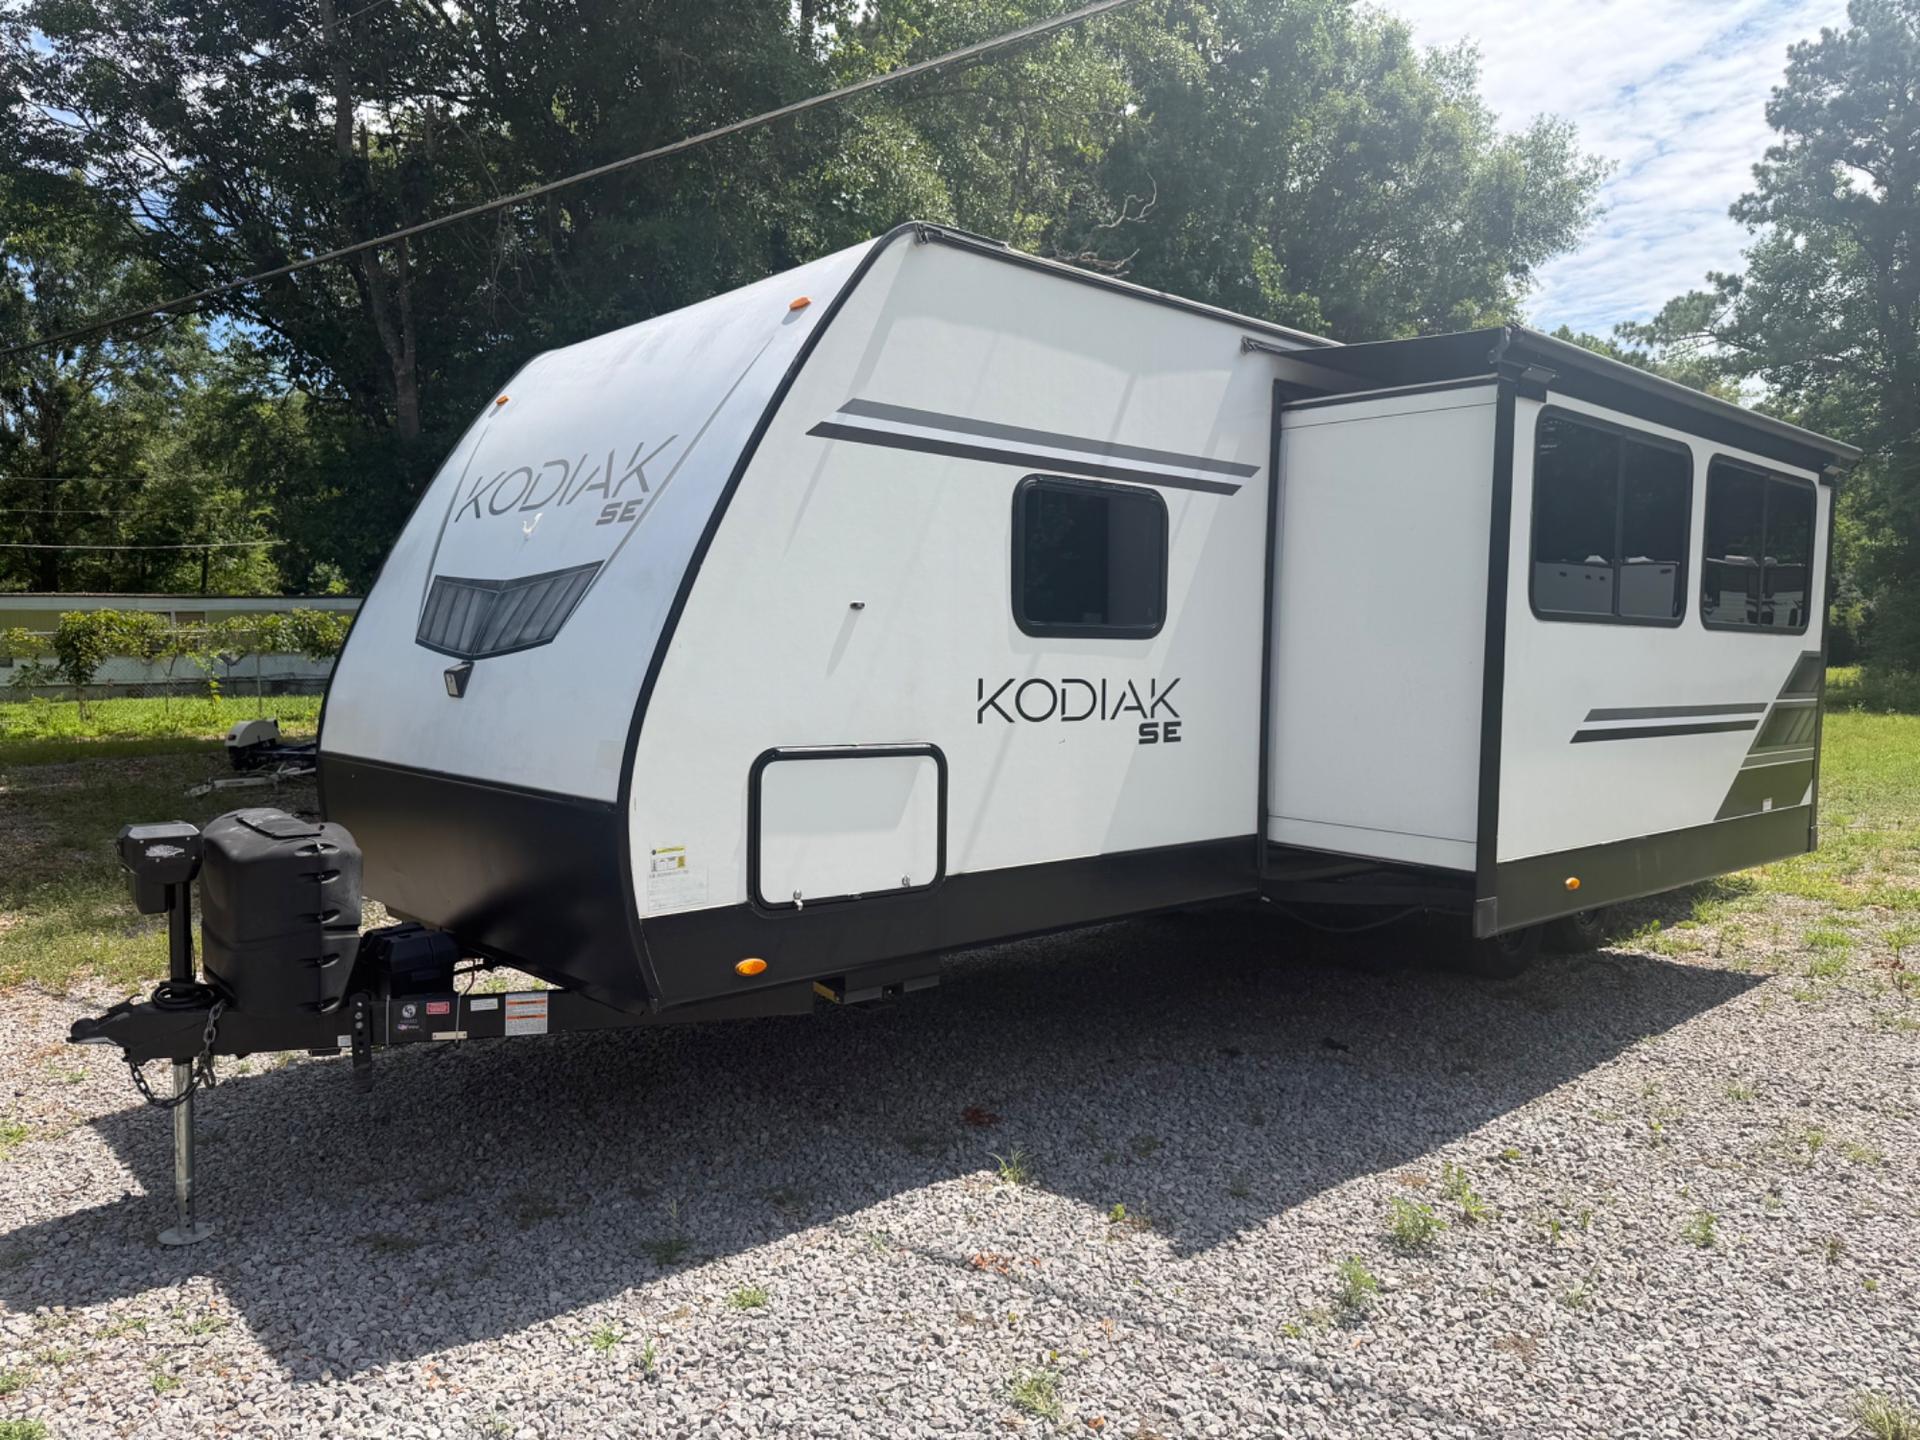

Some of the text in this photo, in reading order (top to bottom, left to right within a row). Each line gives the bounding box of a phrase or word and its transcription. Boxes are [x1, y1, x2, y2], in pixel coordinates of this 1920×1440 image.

[454, 434, 679, 523] KODIAK
[595, 498, 644, 526] SE
[977, 677, 1181, 724] KODIAK
[1138, 721, 1182, 744] SE
